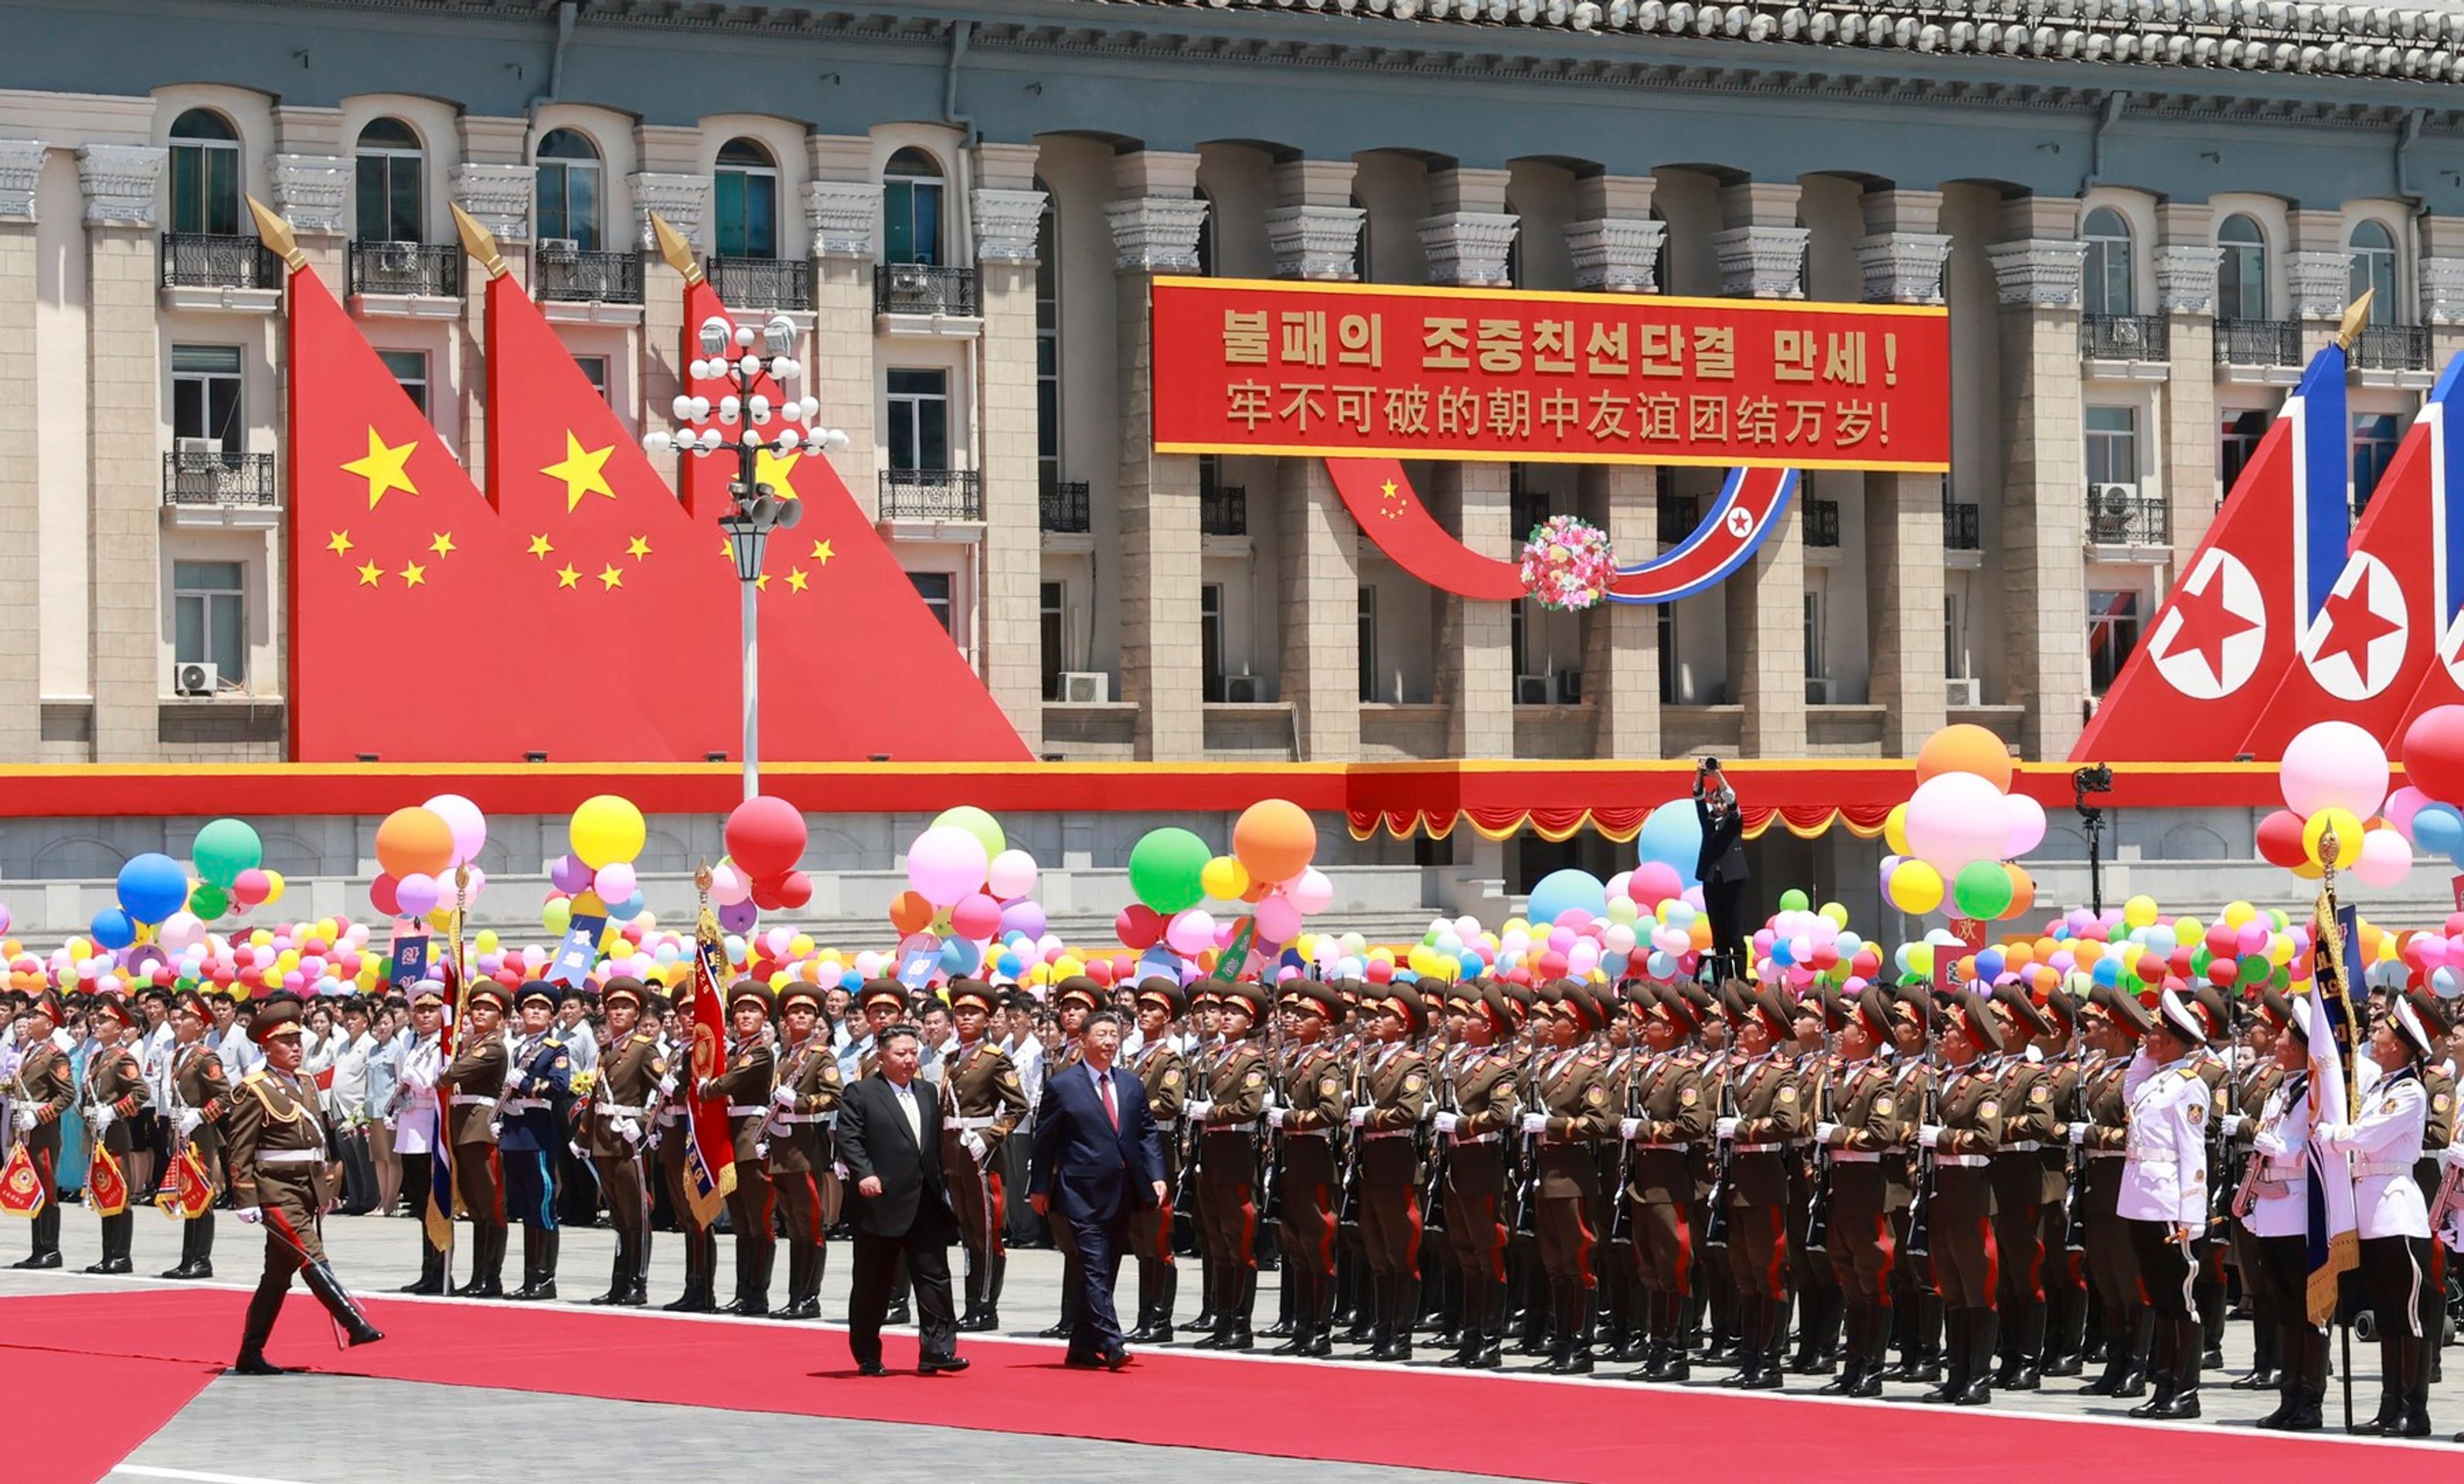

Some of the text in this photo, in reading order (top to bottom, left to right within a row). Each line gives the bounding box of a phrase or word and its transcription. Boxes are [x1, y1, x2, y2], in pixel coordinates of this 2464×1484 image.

[1223, 309, 1897, 386] 불패의 조중친선단결 만세!
[1227, 379, 1890, 447] 牢不可破的朝中友谊团结万岁!
